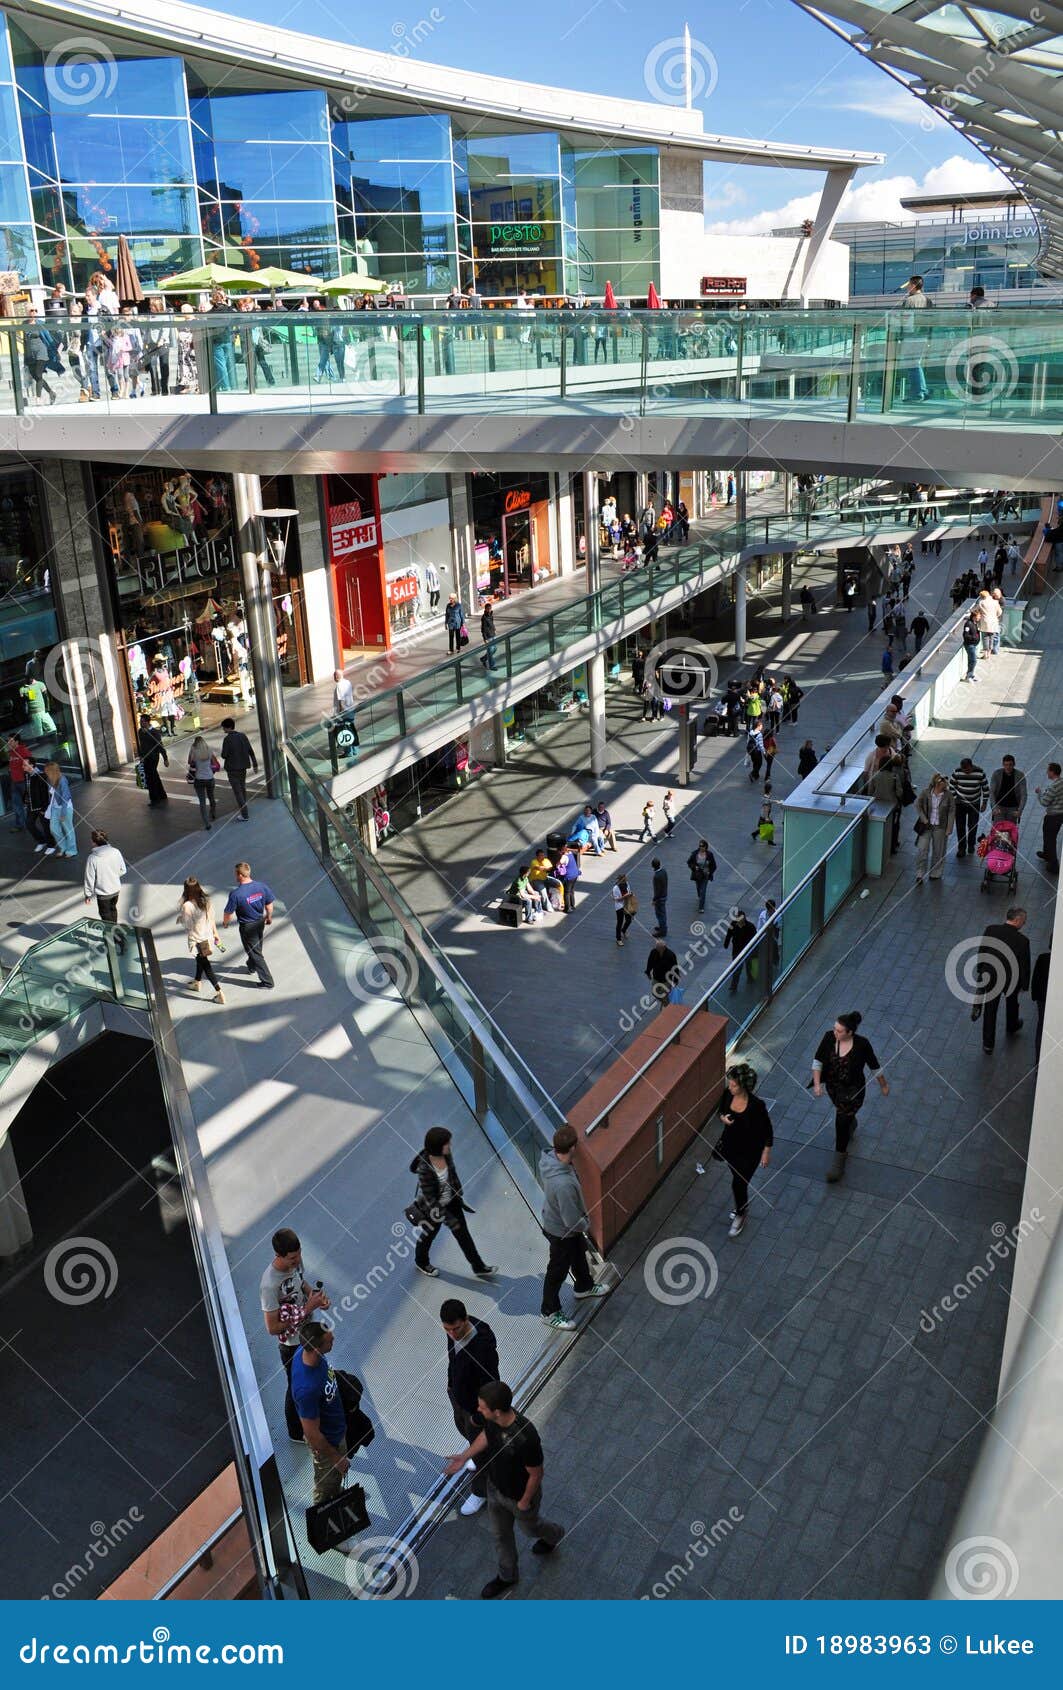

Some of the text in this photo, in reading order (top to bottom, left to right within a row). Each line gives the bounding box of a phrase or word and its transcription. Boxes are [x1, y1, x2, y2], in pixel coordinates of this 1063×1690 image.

[490, 225, 541, 244] PESTO
[963, 224, 1000, 245] John
[332, 522, 375, 551] ESPRIT
[393, 581, 415, 601] SALE
[340, 733, 352, 744] JD
